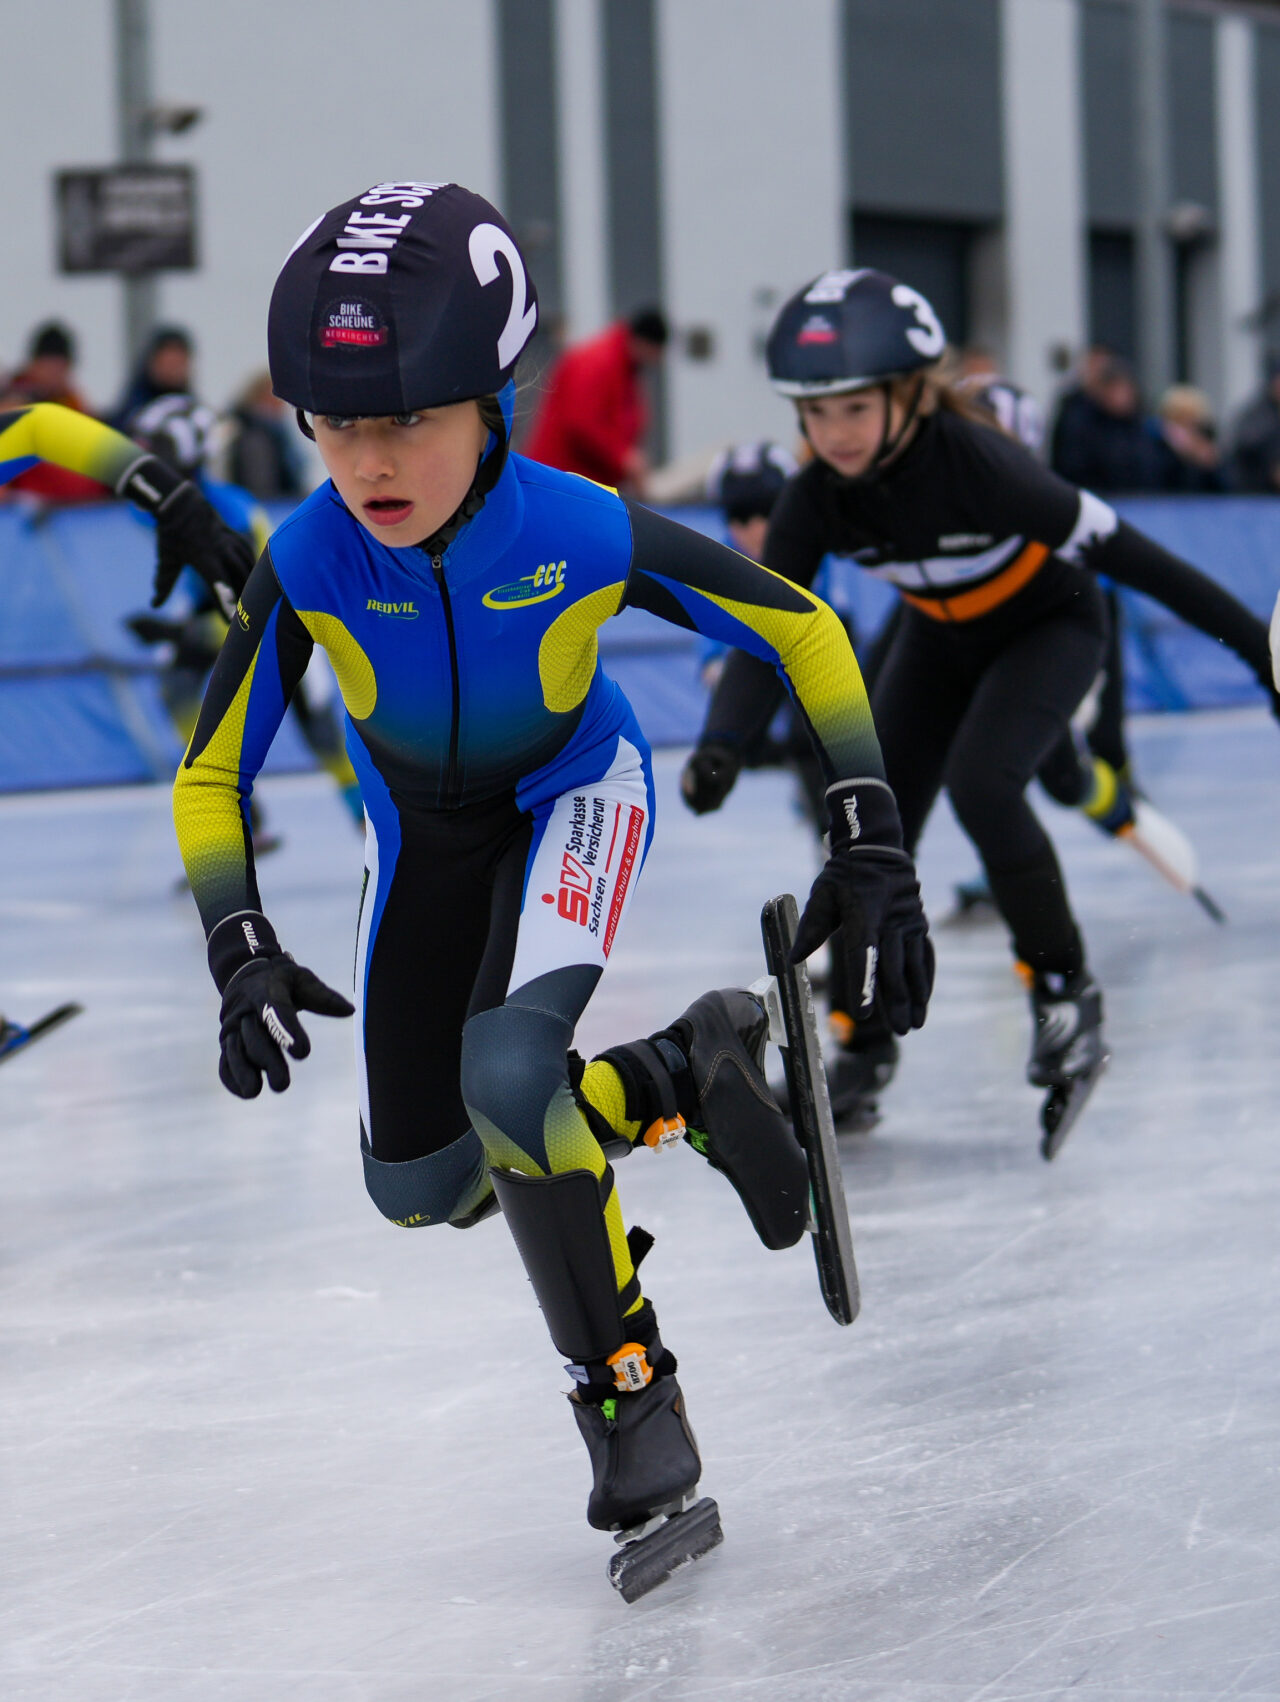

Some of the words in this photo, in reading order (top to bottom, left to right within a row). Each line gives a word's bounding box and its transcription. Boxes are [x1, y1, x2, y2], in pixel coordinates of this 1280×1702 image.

[329, 211, 412, 274] BIKE
[329, 314, 375, 329] SCHEUNE
[340, 303, 362, 316] BIKE
[468, 222, 537, 371] 2
[890, 284, 946, 358] 3
[566, 796, 587, 854] Sparkasse
[582, 797, 606, 867] Versicherun
[588, 876, 607, 938] Sachsen
[605, 905, 620, 955] Agentur
[616, 867, 630, 905] Schulz
[624, 857, 632, 867] &
